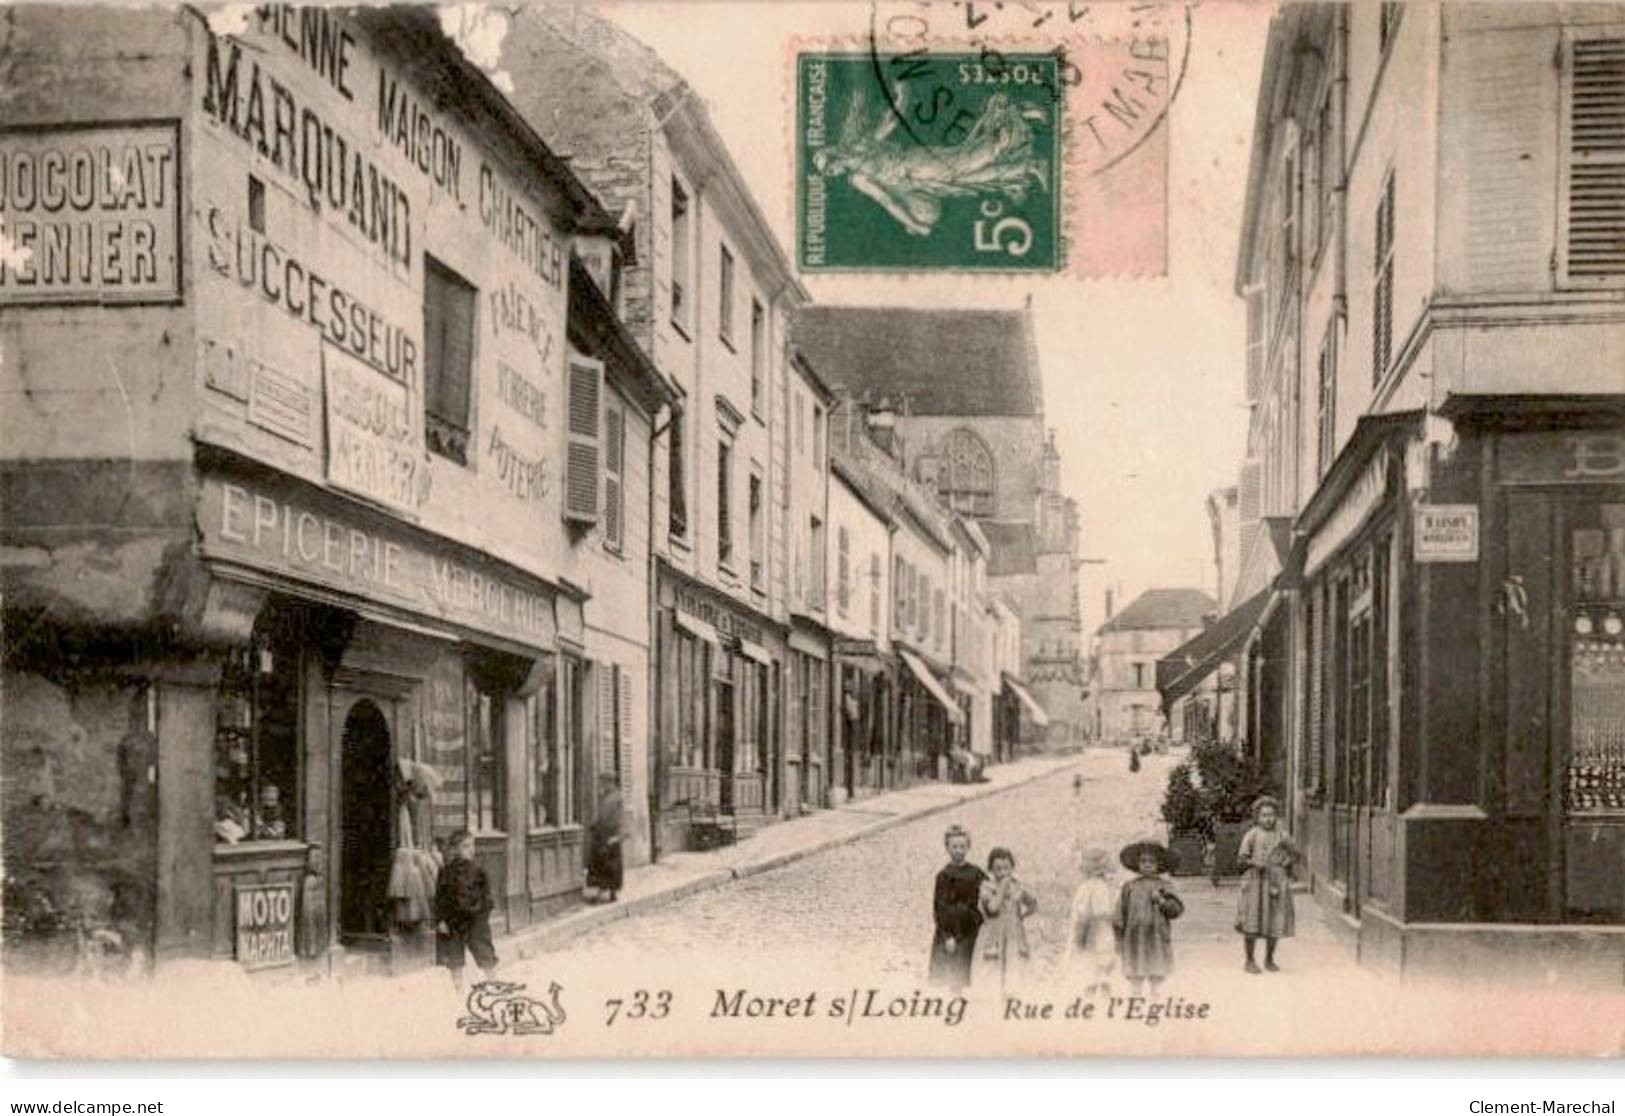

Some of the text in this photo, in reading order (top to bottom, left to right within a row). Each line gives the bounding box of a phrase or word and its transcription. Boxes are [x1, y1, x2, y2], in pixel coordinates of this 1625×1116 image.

[203, 30, 413, 270] MARQUAND
[0, 219, 157, 286] ENIER
[479, 161, 562, 292] CHARTIER
[207, 205, 418, 391] SUCCESSEUR
[220, 483, 401, 588] EPICERIE
[240, 890, 291, 927] MOTO
